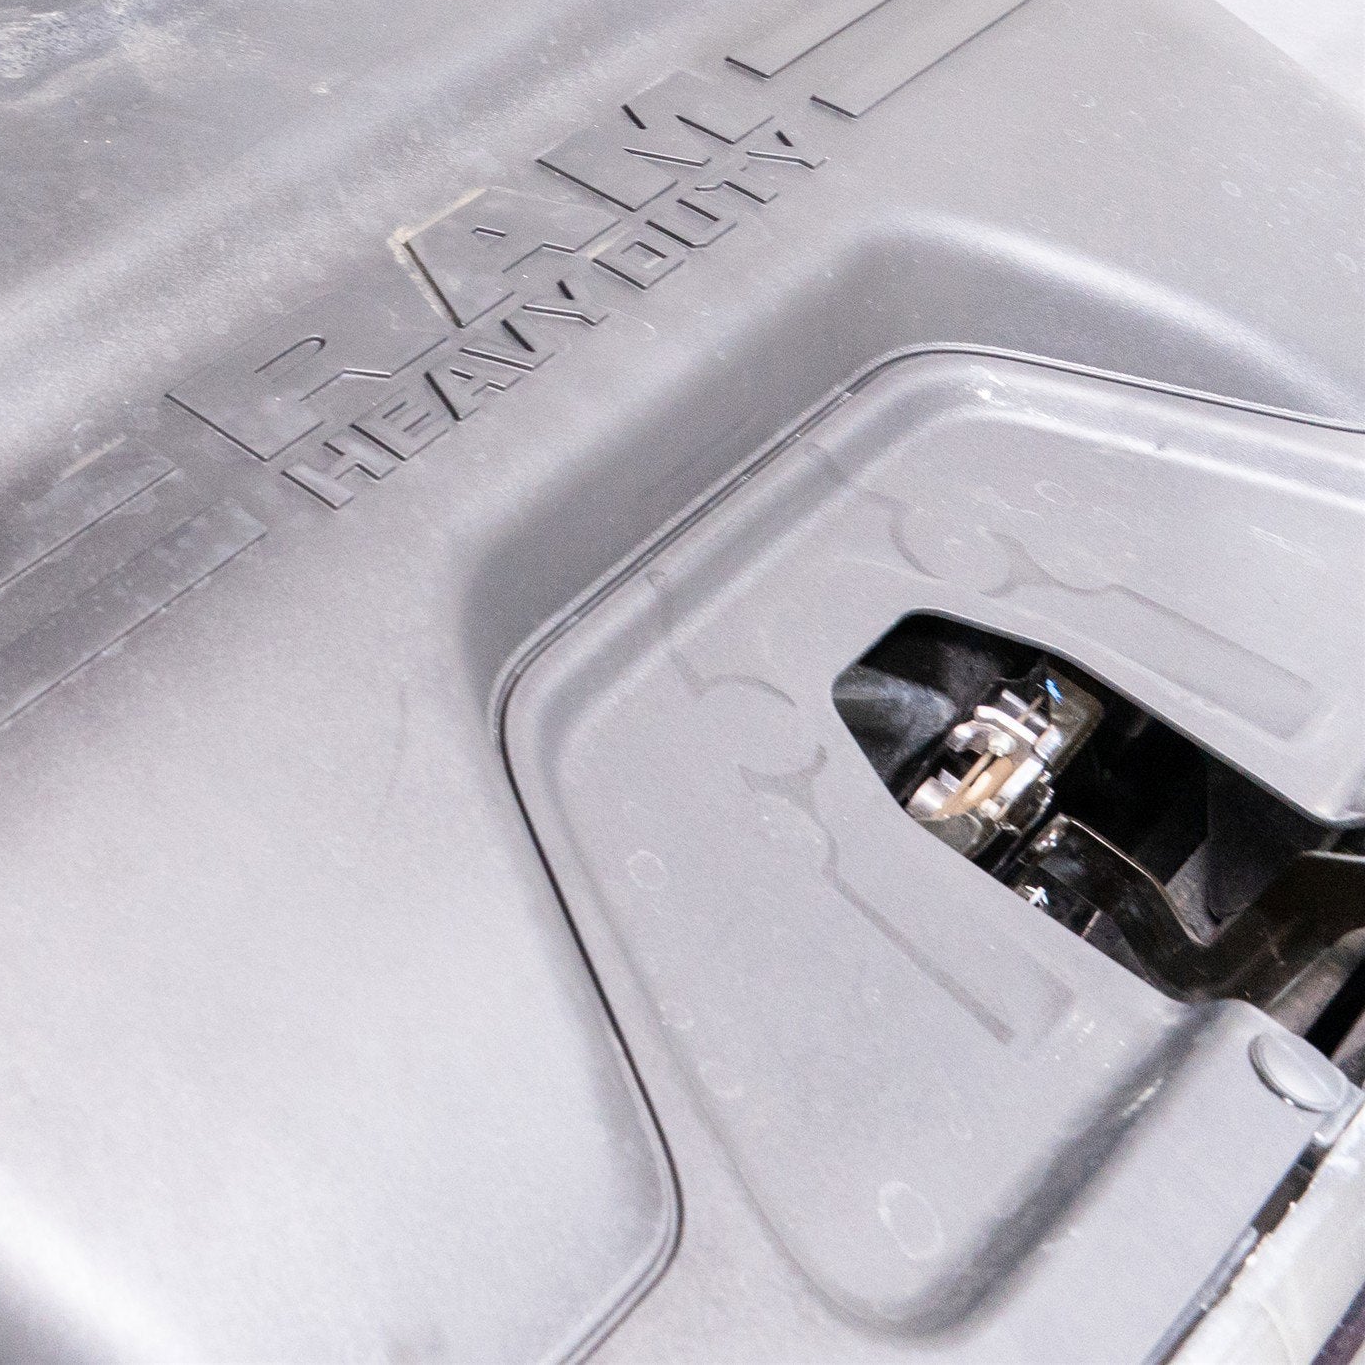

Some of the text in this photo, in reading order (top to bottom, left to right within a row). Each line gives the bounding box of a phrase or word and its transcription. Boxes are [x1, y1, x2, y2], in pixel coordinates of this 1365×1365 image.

[165, 69, 775, 464] RAM
[280, 129, 829, 511] HEAVY DUTY
